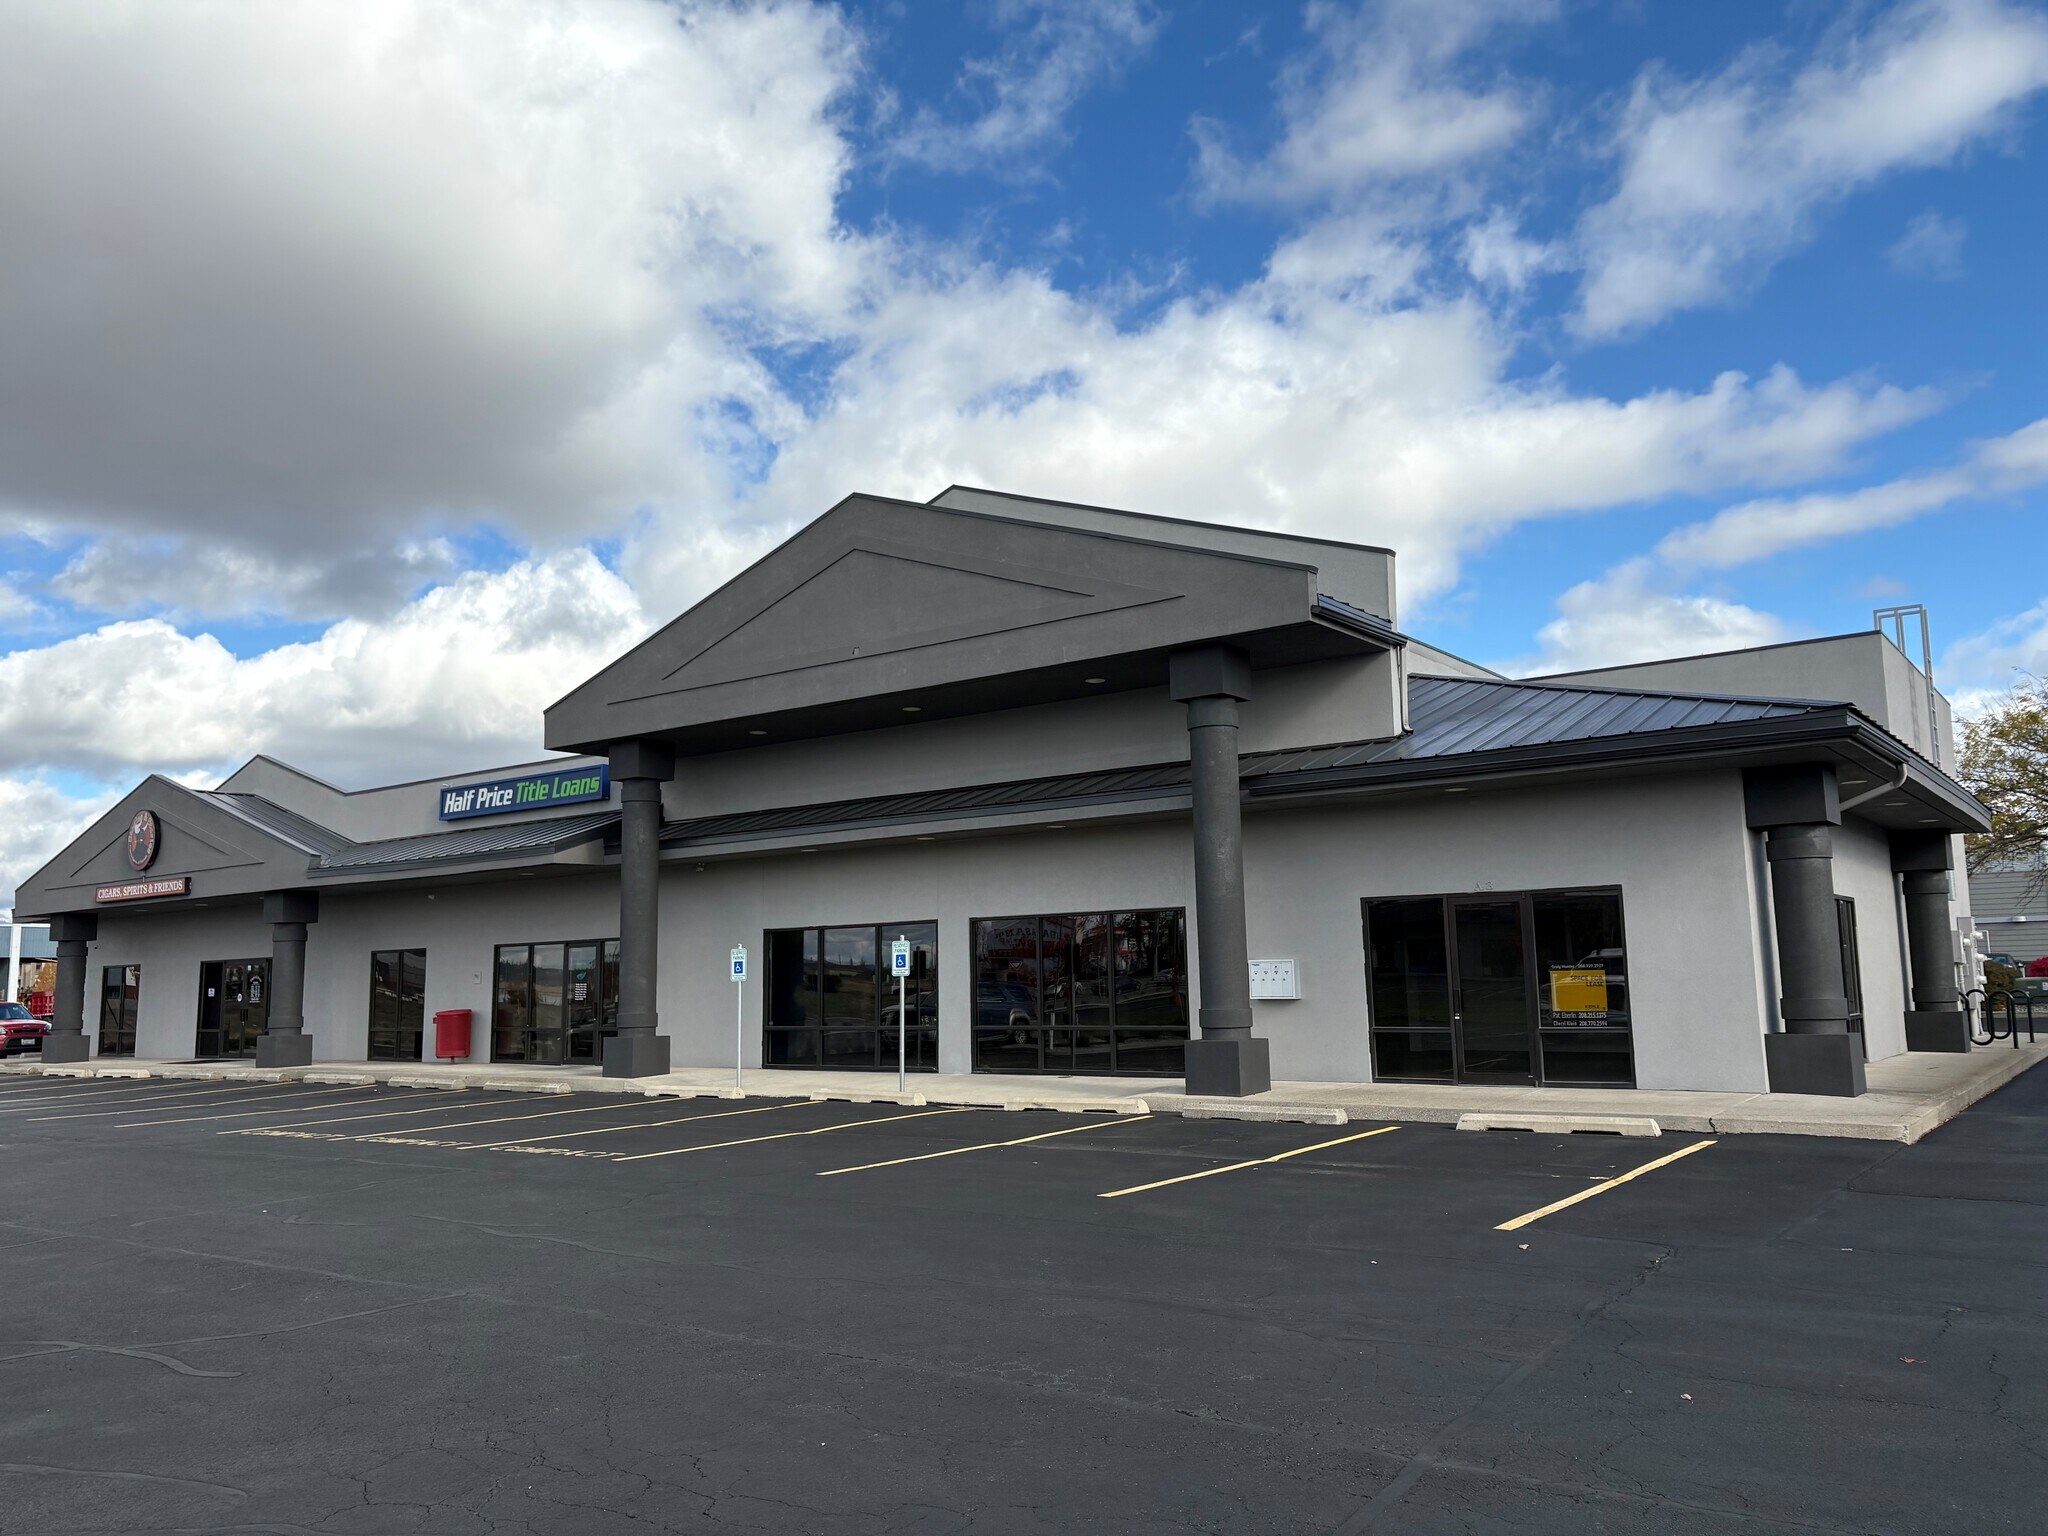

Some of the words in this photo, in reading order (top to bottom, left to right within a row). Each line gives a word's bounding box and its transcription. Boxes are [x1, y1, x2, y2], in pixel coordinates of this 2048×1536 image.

[444, 789, 475, 814] Half
[476, 786, 513, 809] Price
[516, 780, 549, 804] Title
[551, 776, 600, 799] Loans
[97, 888, 122, 899] CIGARS,
[123, 884, 147, 897] SPIRITS
[148, 884, 153, 893] &
[154, 880, 183, 893] FRIENDS
